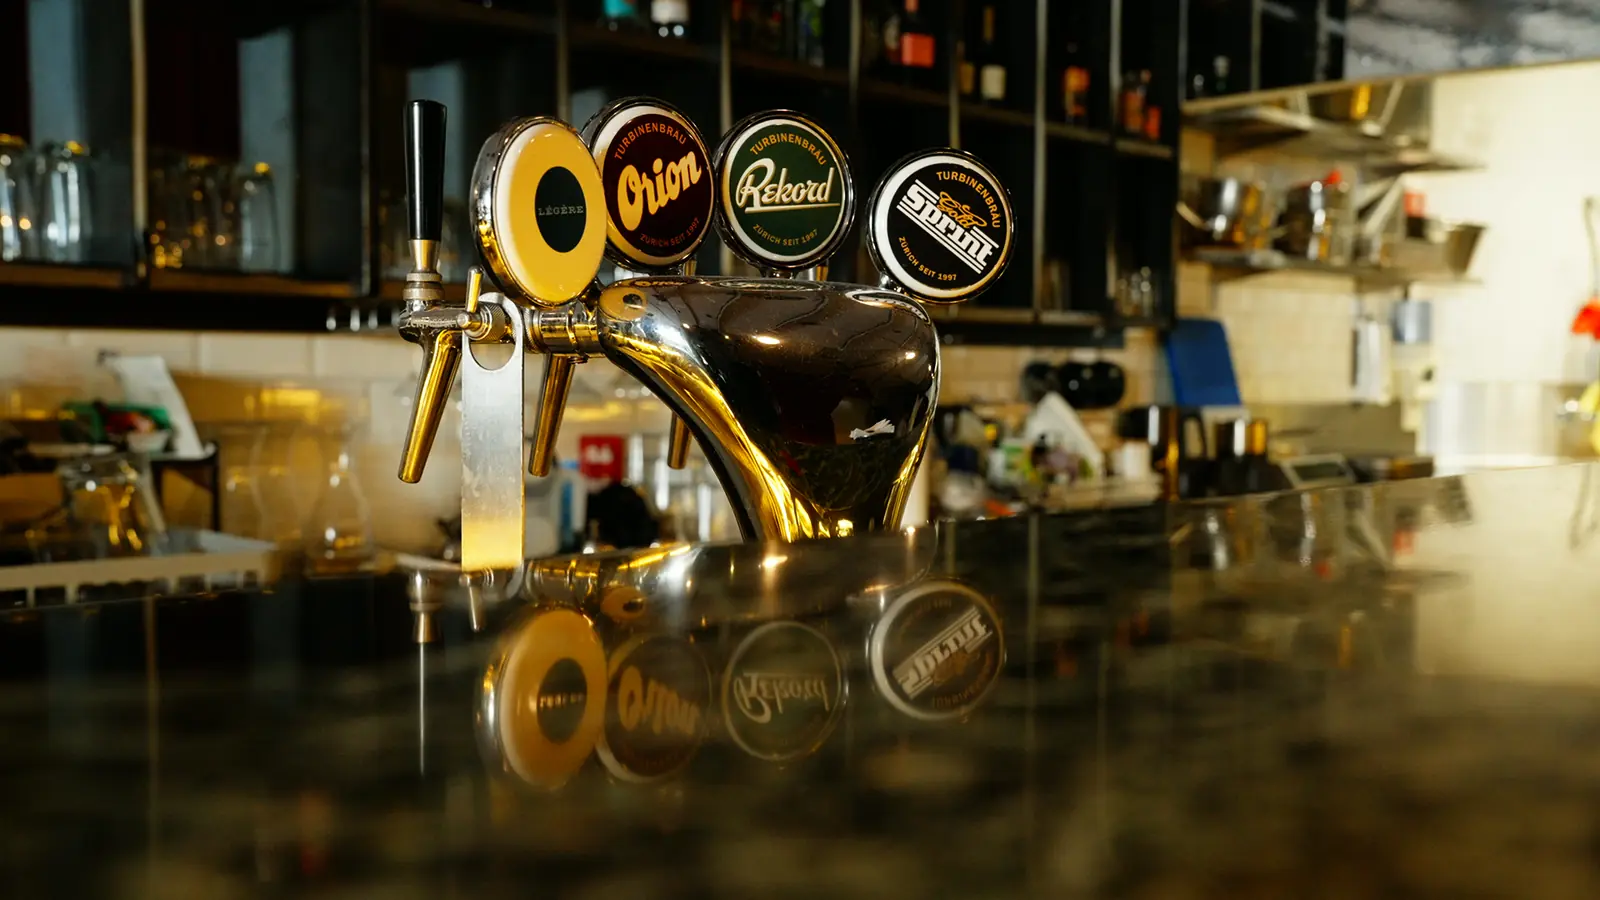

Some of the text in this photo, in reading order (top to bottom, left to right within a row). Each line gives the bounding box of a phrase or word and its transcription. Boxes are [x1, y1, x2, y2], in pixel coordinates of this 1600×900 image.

[617, 151, 702, 232] Orion
[735, 157, 836, 209] Rekord
[671, 234, 686, 246] SEIT
[783, 237, 800, 246] SEIT
[901, 183, 994, 267] Sprint
[918, 264, 938, 278] SEIT
[937, 273, 957, 281] 1997
